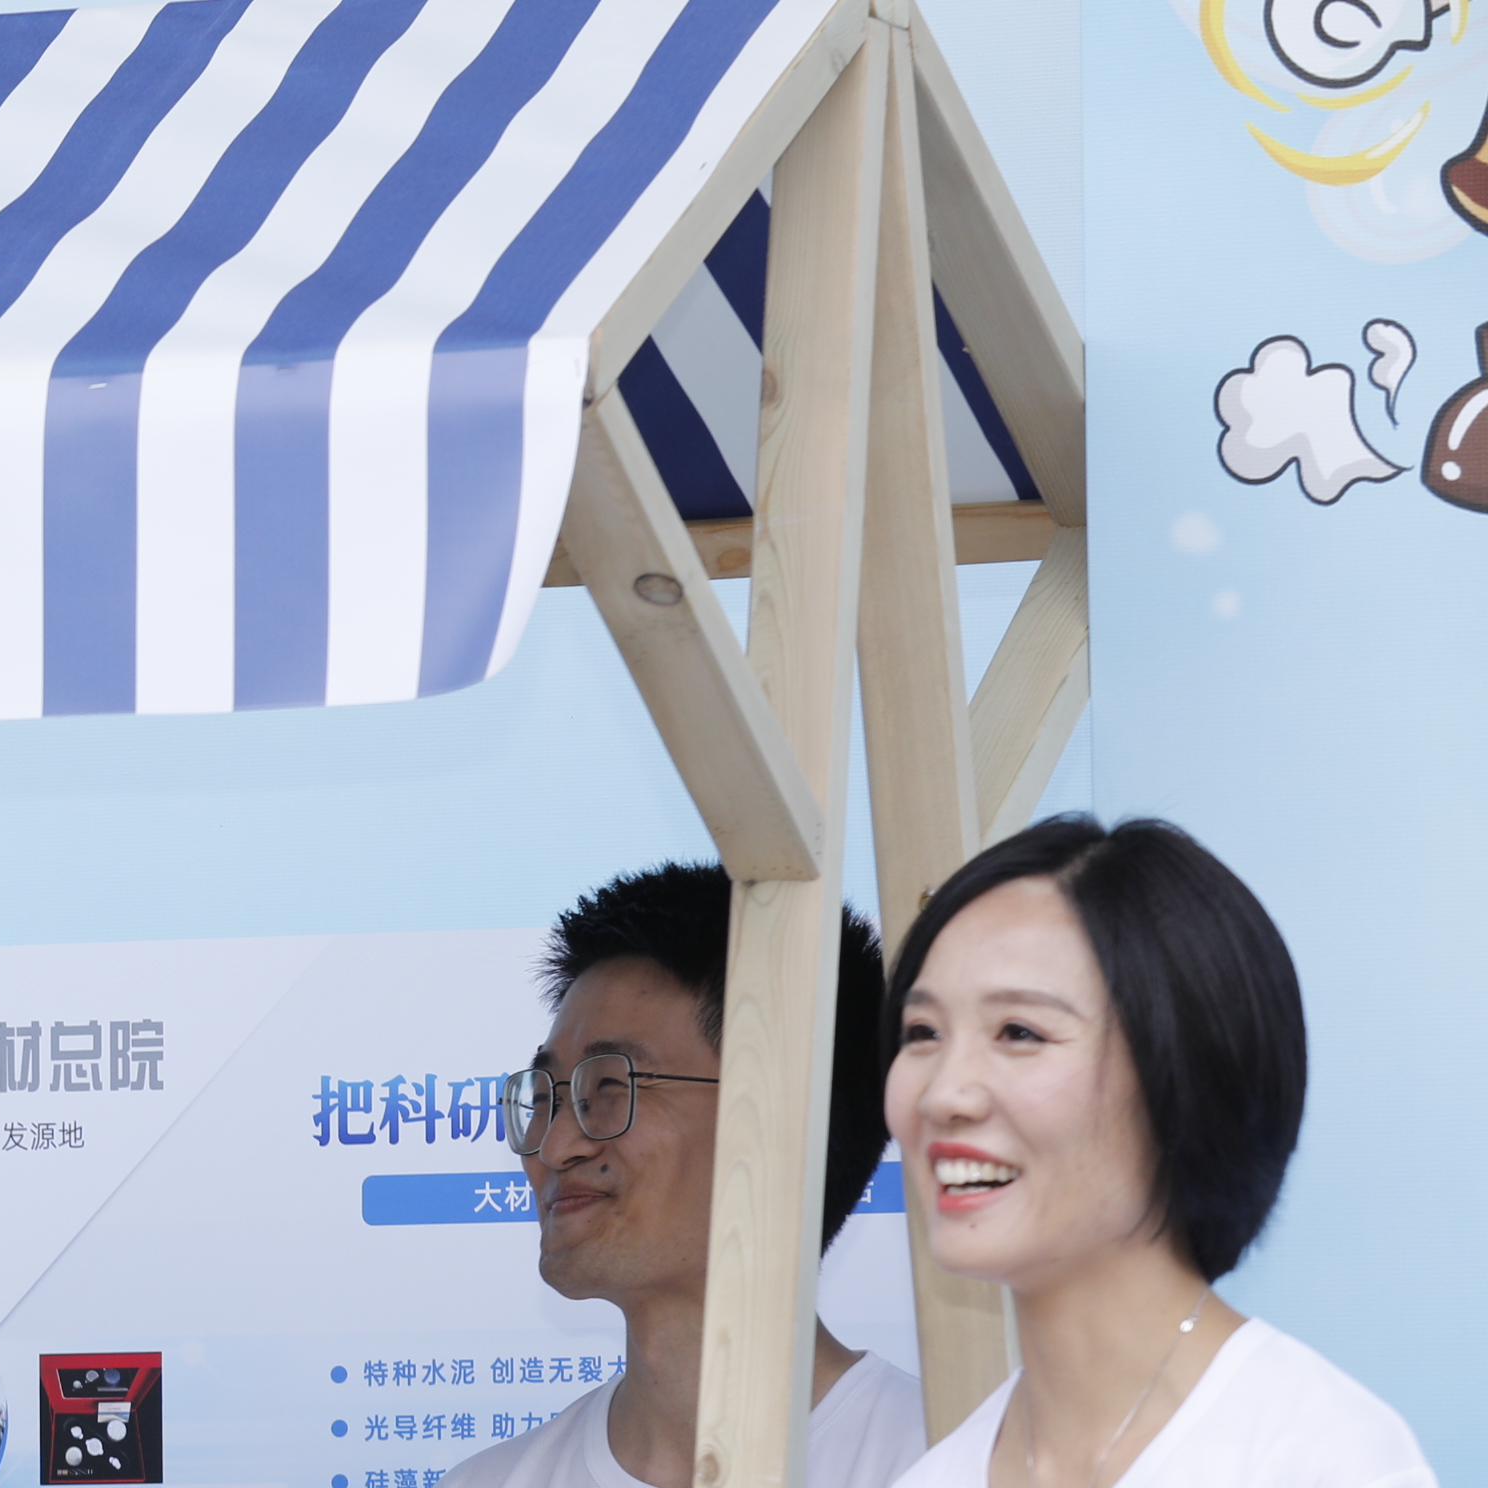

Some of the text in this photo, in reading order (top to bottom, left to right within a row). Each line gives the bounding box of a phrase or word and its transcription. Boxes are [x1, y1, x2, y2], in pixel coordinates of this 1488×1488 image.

[311, 1071, 511, 1147] 把科研
[473, 1180, 534, 1213] 大材
[363, 1358, 476, 1387] 特种水泥
[364, 1411, 561, 1442] 光导纤维 助力
